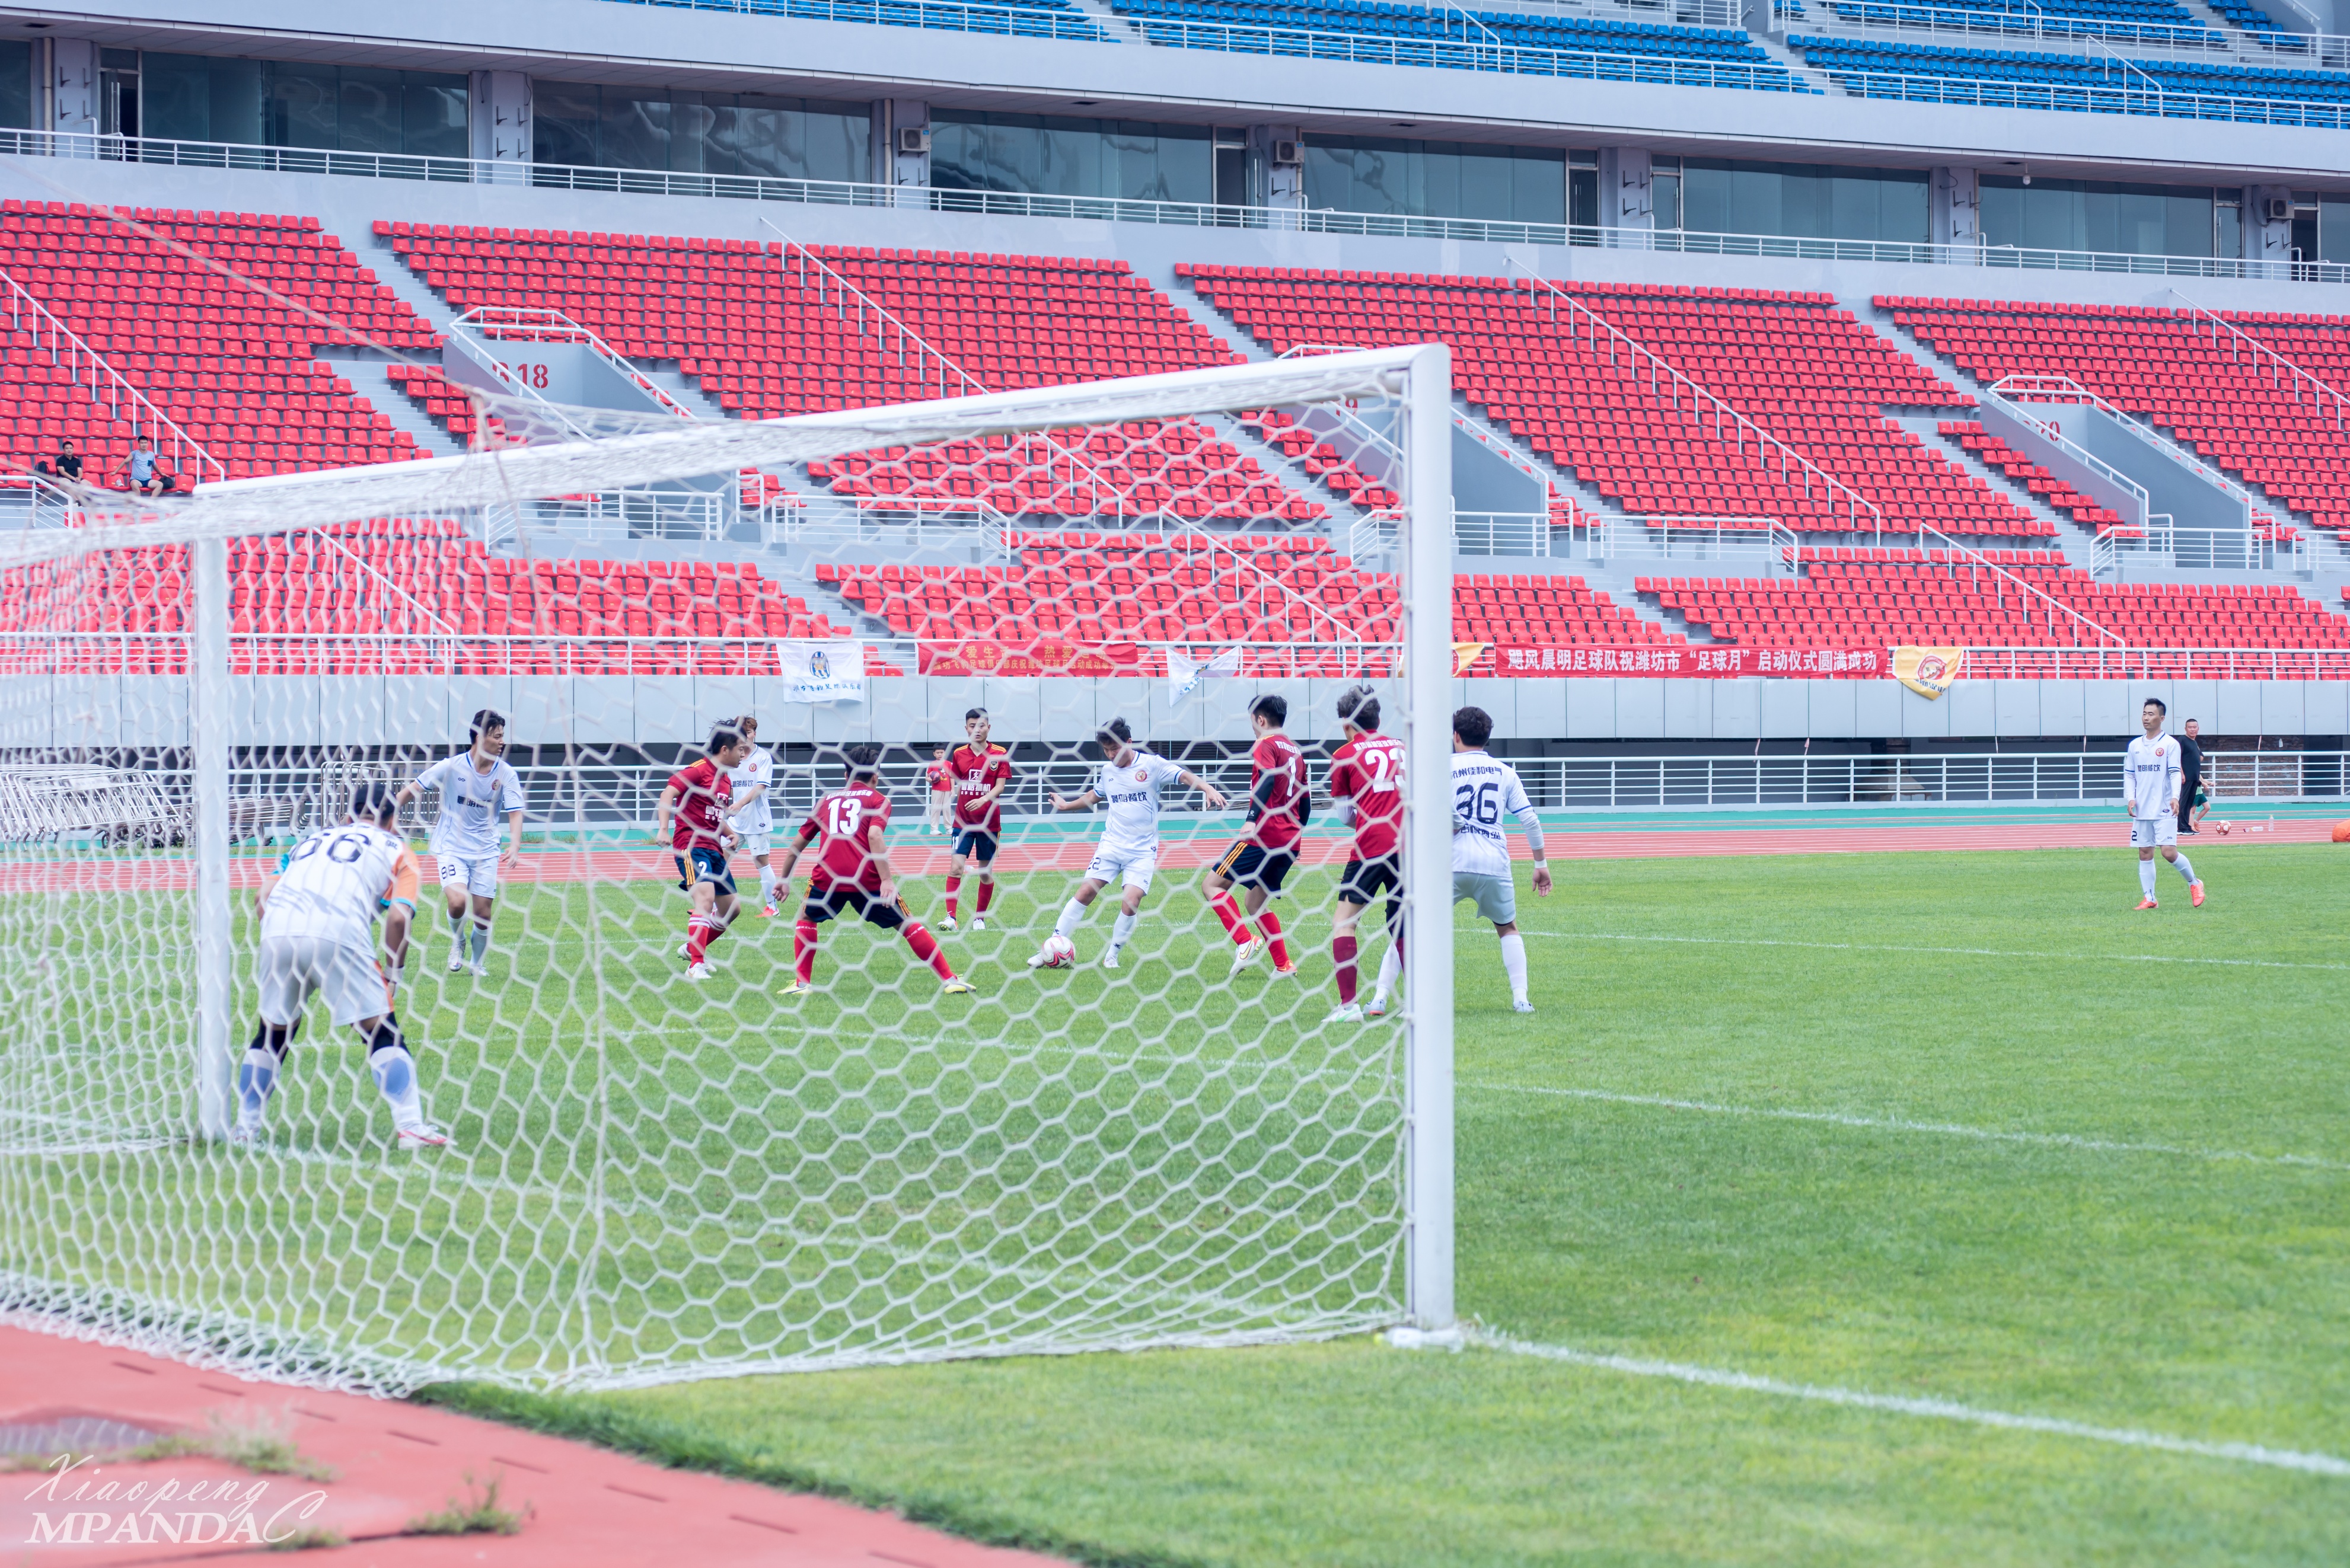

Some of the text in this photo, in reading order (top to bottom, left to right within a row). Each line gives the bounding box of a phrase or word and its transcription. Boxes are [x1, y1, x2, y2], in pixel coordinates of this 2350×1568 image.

[1287, 756, 1296, 797] 1
[828, 798, 861, 835] 13
[1456, 783, 1498, 824] 36
[698, 861, 708, 876] 2
